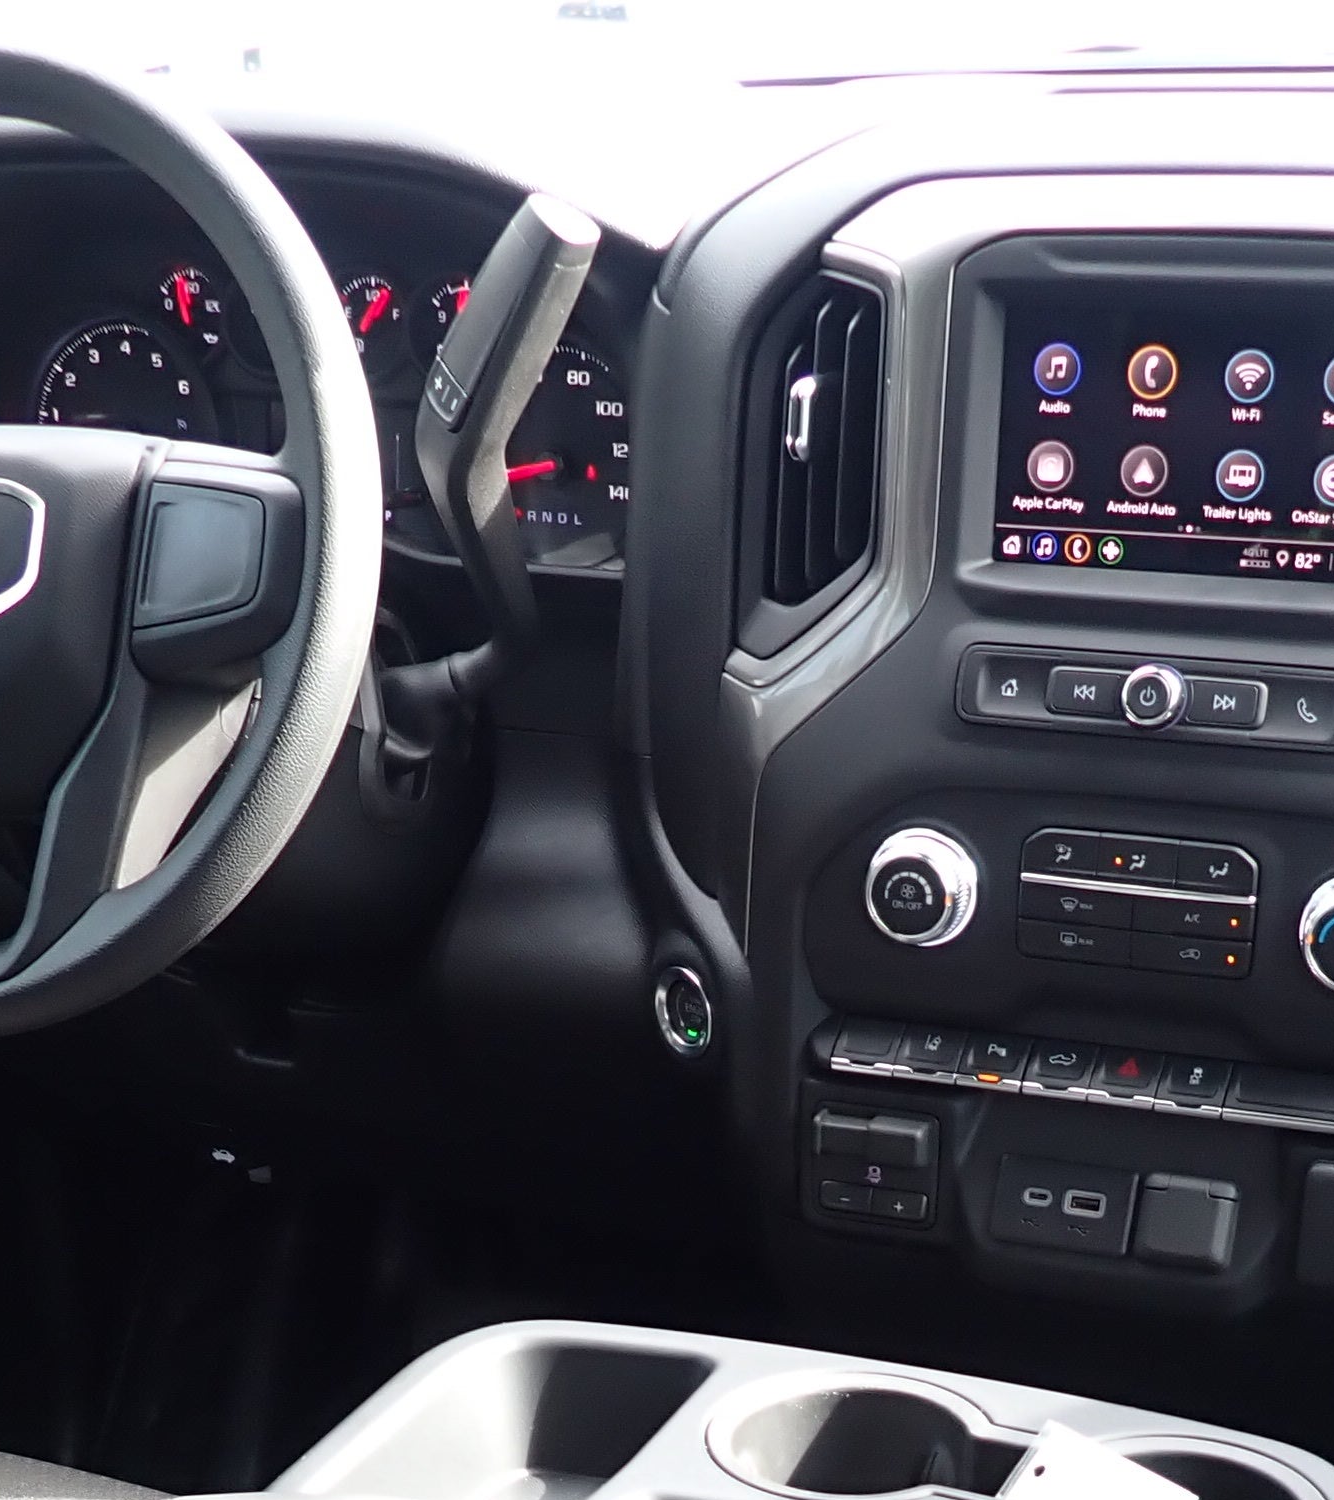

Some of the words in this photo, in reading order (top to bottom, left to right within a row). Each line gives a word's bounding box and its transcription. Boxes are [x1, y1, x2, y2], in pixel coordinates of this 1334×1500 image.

[392, 308, 400, 320] F
[437, 310, 446, 323] 9
[120, 340, 131, 355] 4
[88, 349, 100, 364] 3
[150, 353, 163, 368] 5
[65, 373, 76, 387] 2
[567, 370, 590, 386] 80
[178, 380, 190, 395] 6
[52, 407, 59, 422] 1
[596, 401, 623, 417] 100
[1038, 400, 1071, 414] Audio
[1132, 403, 1167, 418] Phone
[1231, 407, 1261, 421] Wi-Fi
[612, 442, 629, 458] 12
[609, 485, 629, 500] 14
[1012, 495, 1044, 511] Apple
[1045, 498, 1084, 514] CarPlay
[1107, 501, 1148, 515] Android
[1150, 503, 1176, 516] Auto
[527, 510, 536, 522] R
[542, 511, 552, 523] N
[558, 512, 567, 524] D
[574, 513, 582, 525] L
[1202, 505, 1236, 520] Trailer
[1238, 507, 1272, 523] Lights
[1291, 510, 1330, 524] OnStar
[1184, 913, 1200, 924] A/C
